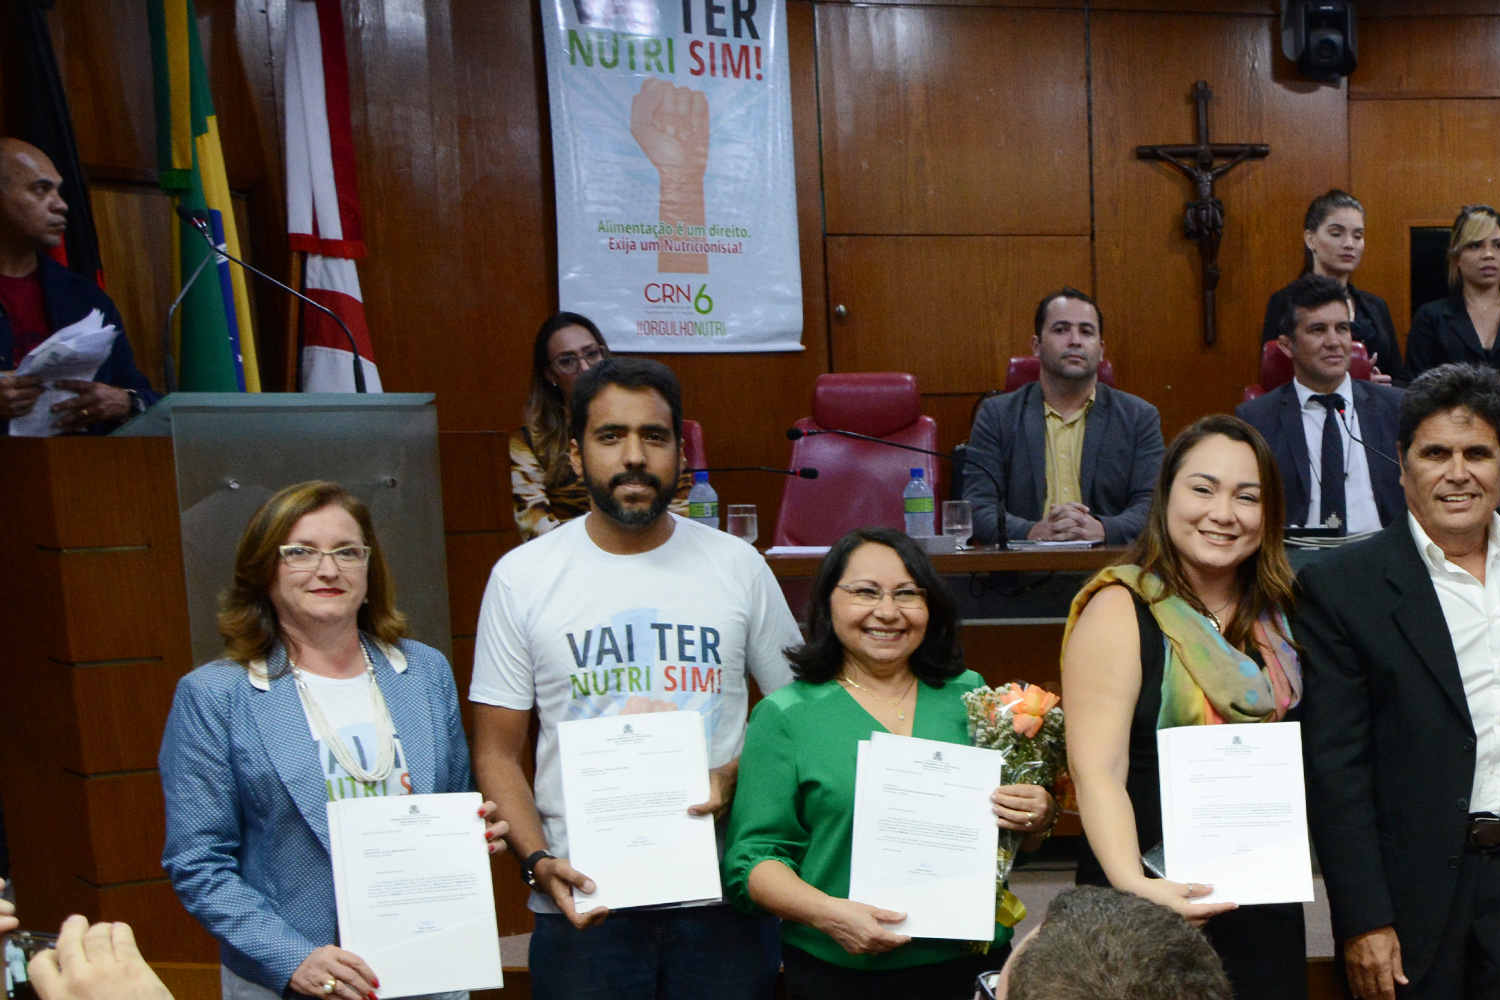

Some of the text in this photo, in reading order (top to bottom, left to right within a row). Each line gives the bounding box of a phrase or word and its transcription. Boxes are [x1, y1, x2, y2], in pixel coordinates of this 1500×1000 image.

[568, 29, 763, 81] NUTRI SIM!
[598, 220, 752, 238] Alimentação é um direito.
[609, 237, 743, 254] Exija um Nutricionista!
[566, 622, 722, 669] VAI TER
[570, 665, 722, 699] NUTRI SIM!
